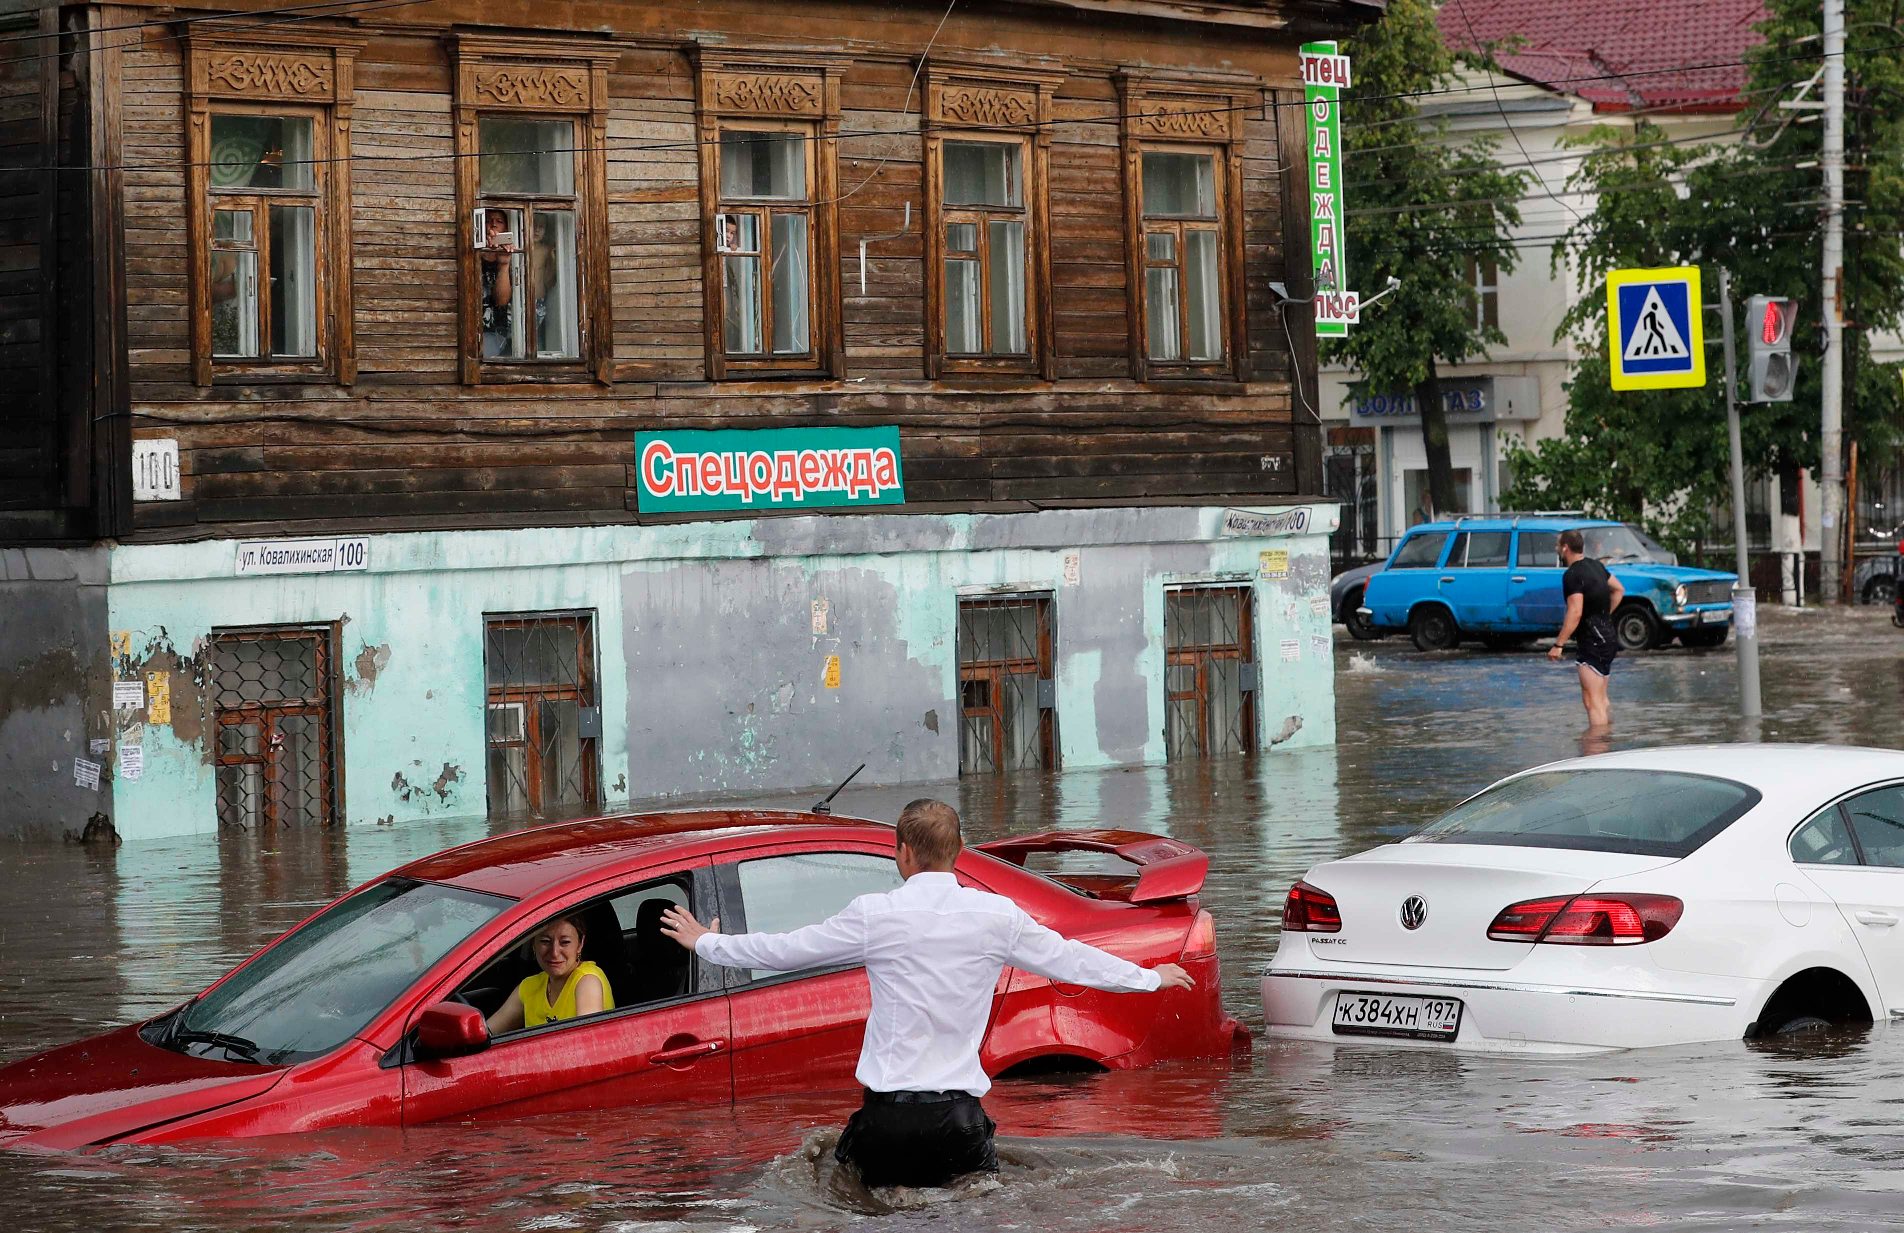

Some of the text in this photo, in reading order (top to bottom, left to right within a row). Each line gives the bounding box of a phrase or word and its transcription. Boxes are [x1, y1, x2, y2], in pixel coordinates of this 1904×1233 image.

[1313, 96, 1336, 286] ОДЕЖДА
[140, 452, 173, 489] 100
[642, 441, 899, 502] Спецодежда
[242, 541, 364, 571] ул. Ковалихинская 100
[1341, 998, 1455, 1026] К384ХН 197
[1427, 1021, 1443, 1029] RUS
